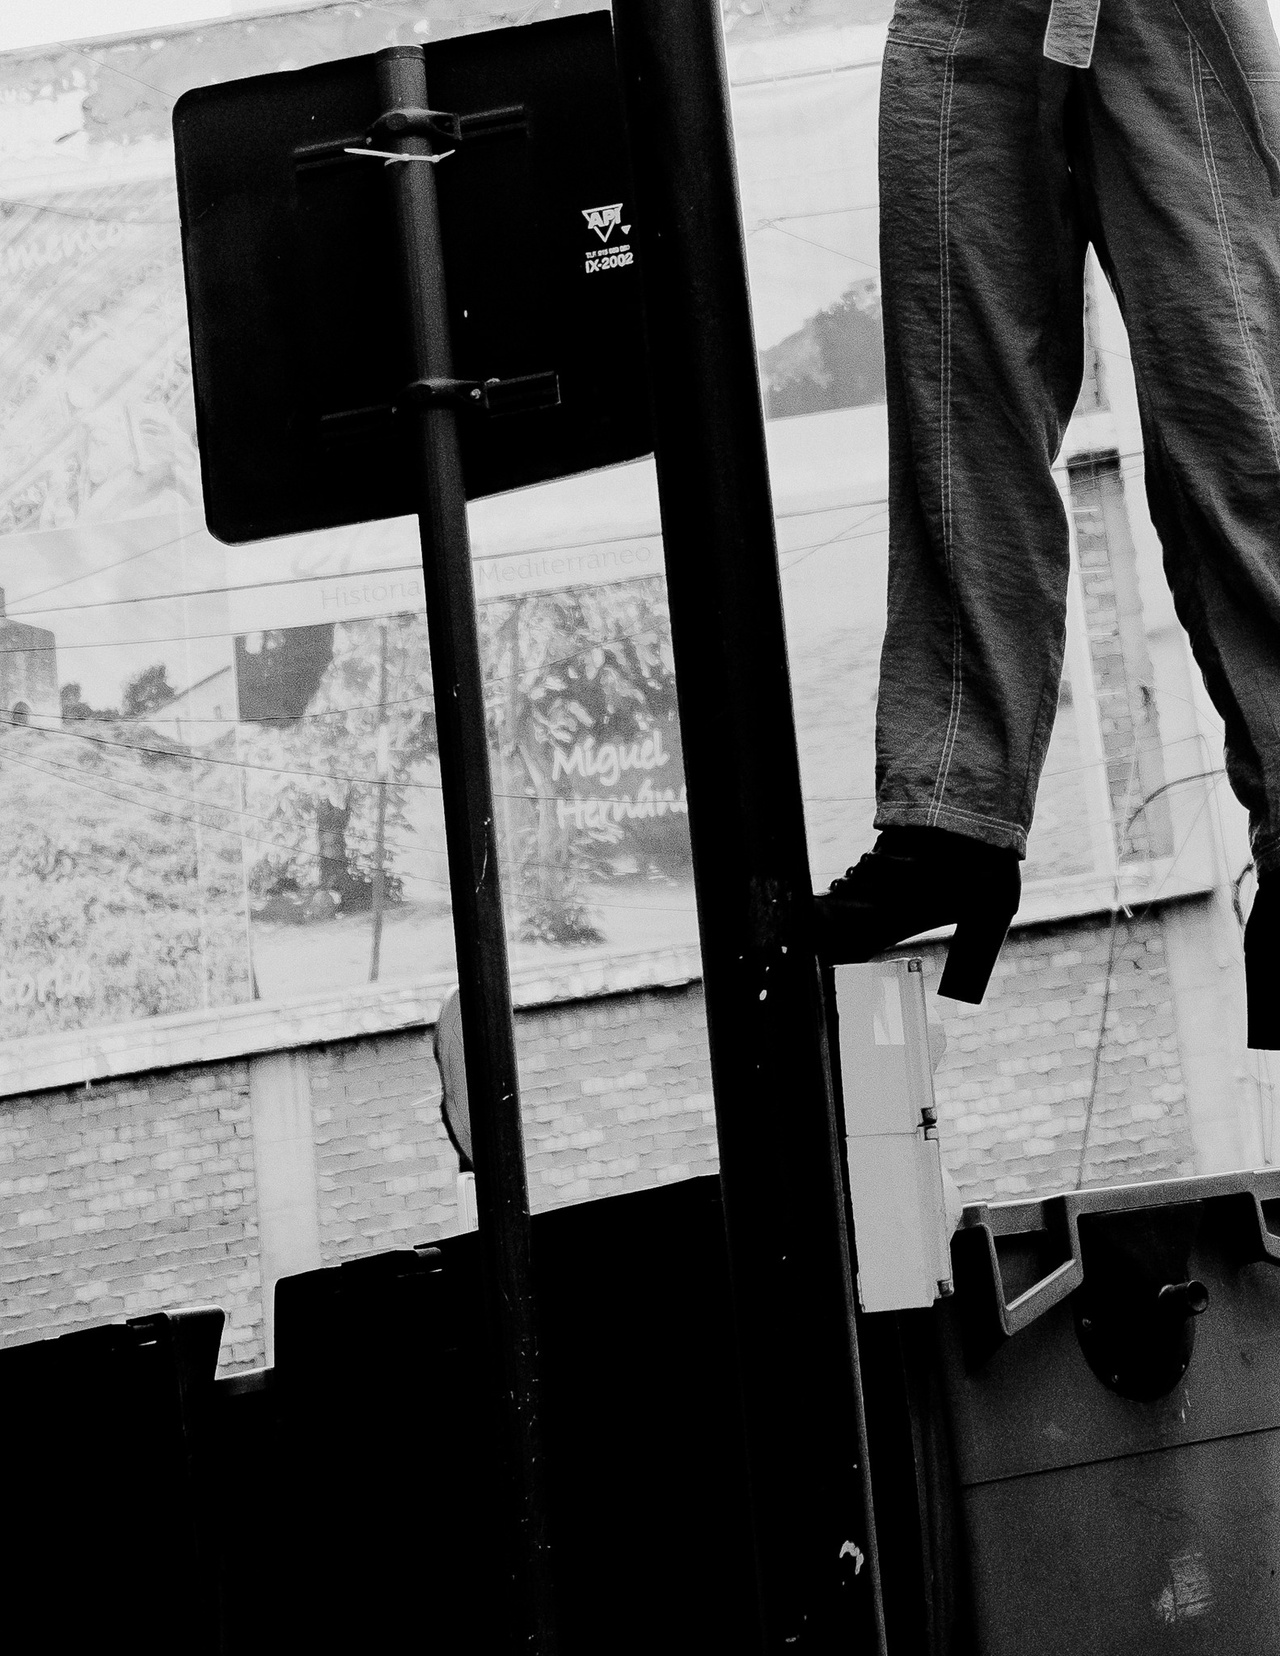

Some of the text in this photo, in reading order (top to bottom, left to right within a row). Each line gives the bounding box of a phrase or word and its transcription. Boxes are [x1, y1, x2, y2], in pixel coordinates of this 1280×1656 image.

[588, 207, 621, 229] API
[585, 252, 634, 273] IX-2002
[320, 580, 422, 609] Historia
[551, 728, 671, 786] Miguel
